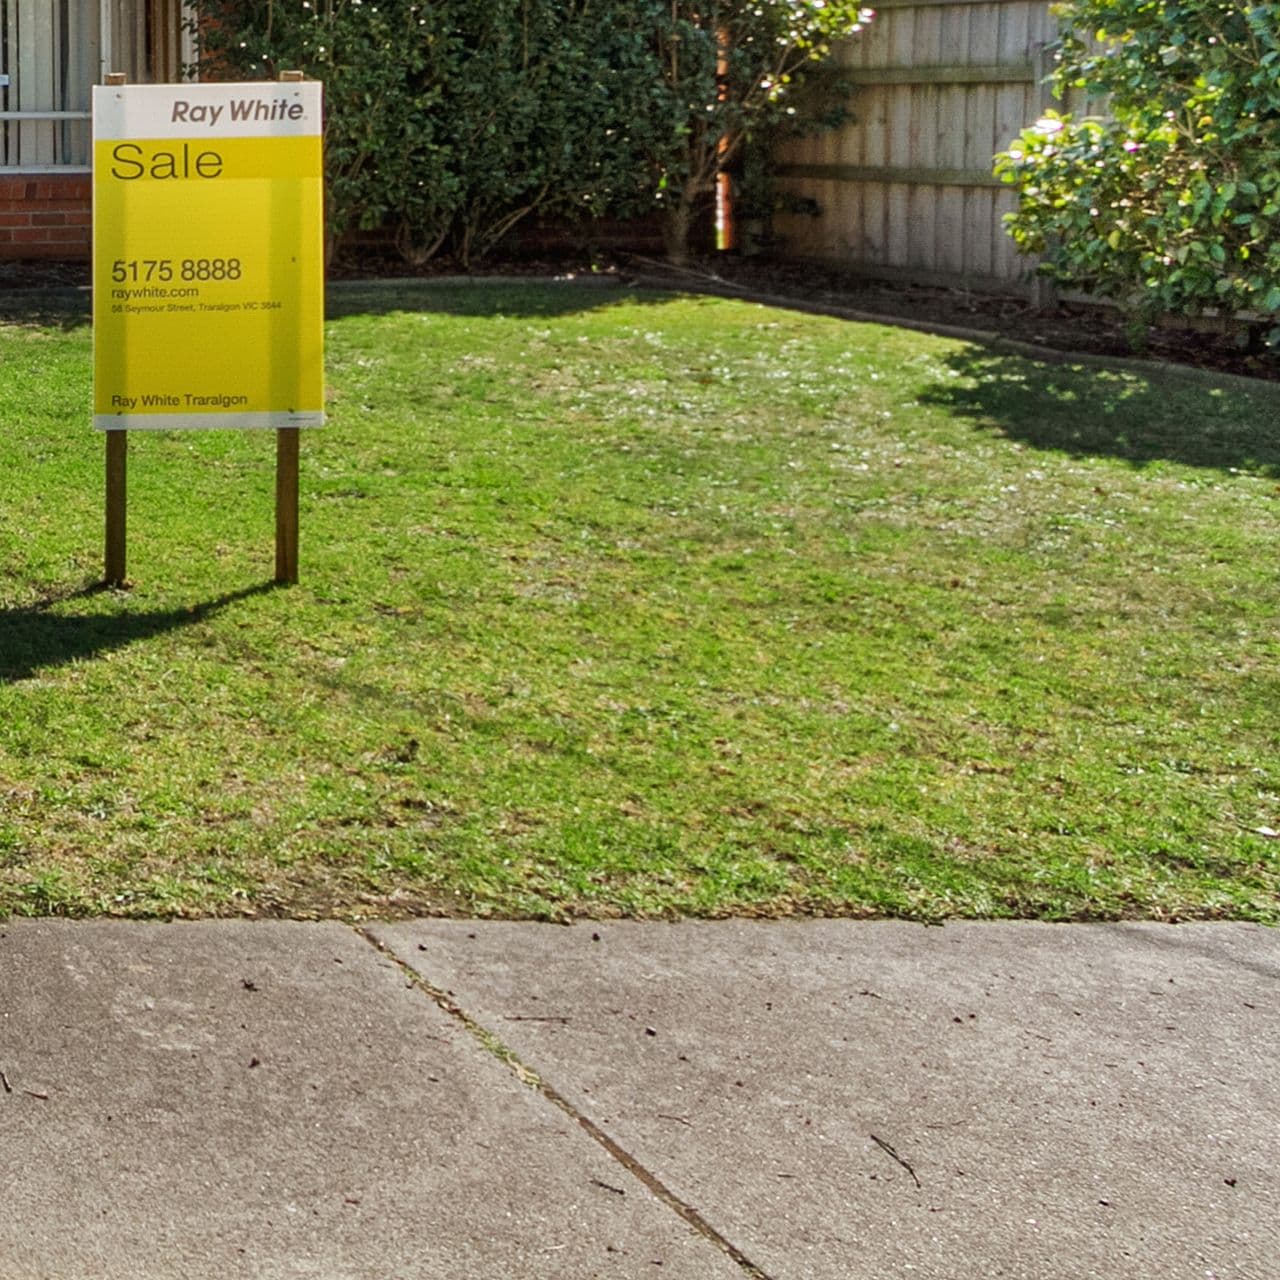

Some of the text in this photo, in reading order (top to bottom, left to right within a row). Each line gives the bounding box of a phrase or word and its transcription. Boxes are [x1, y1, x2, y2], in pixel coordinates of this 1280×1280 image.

[171, 99, 304, 126] Ray White
[111, 143, 223, 180] Sale
[111, 258, 242, 283] 5175 8888
[111, 287, 199, 301] raywhite.com
[111, 394, 248, 409] Ray White Traralgon
